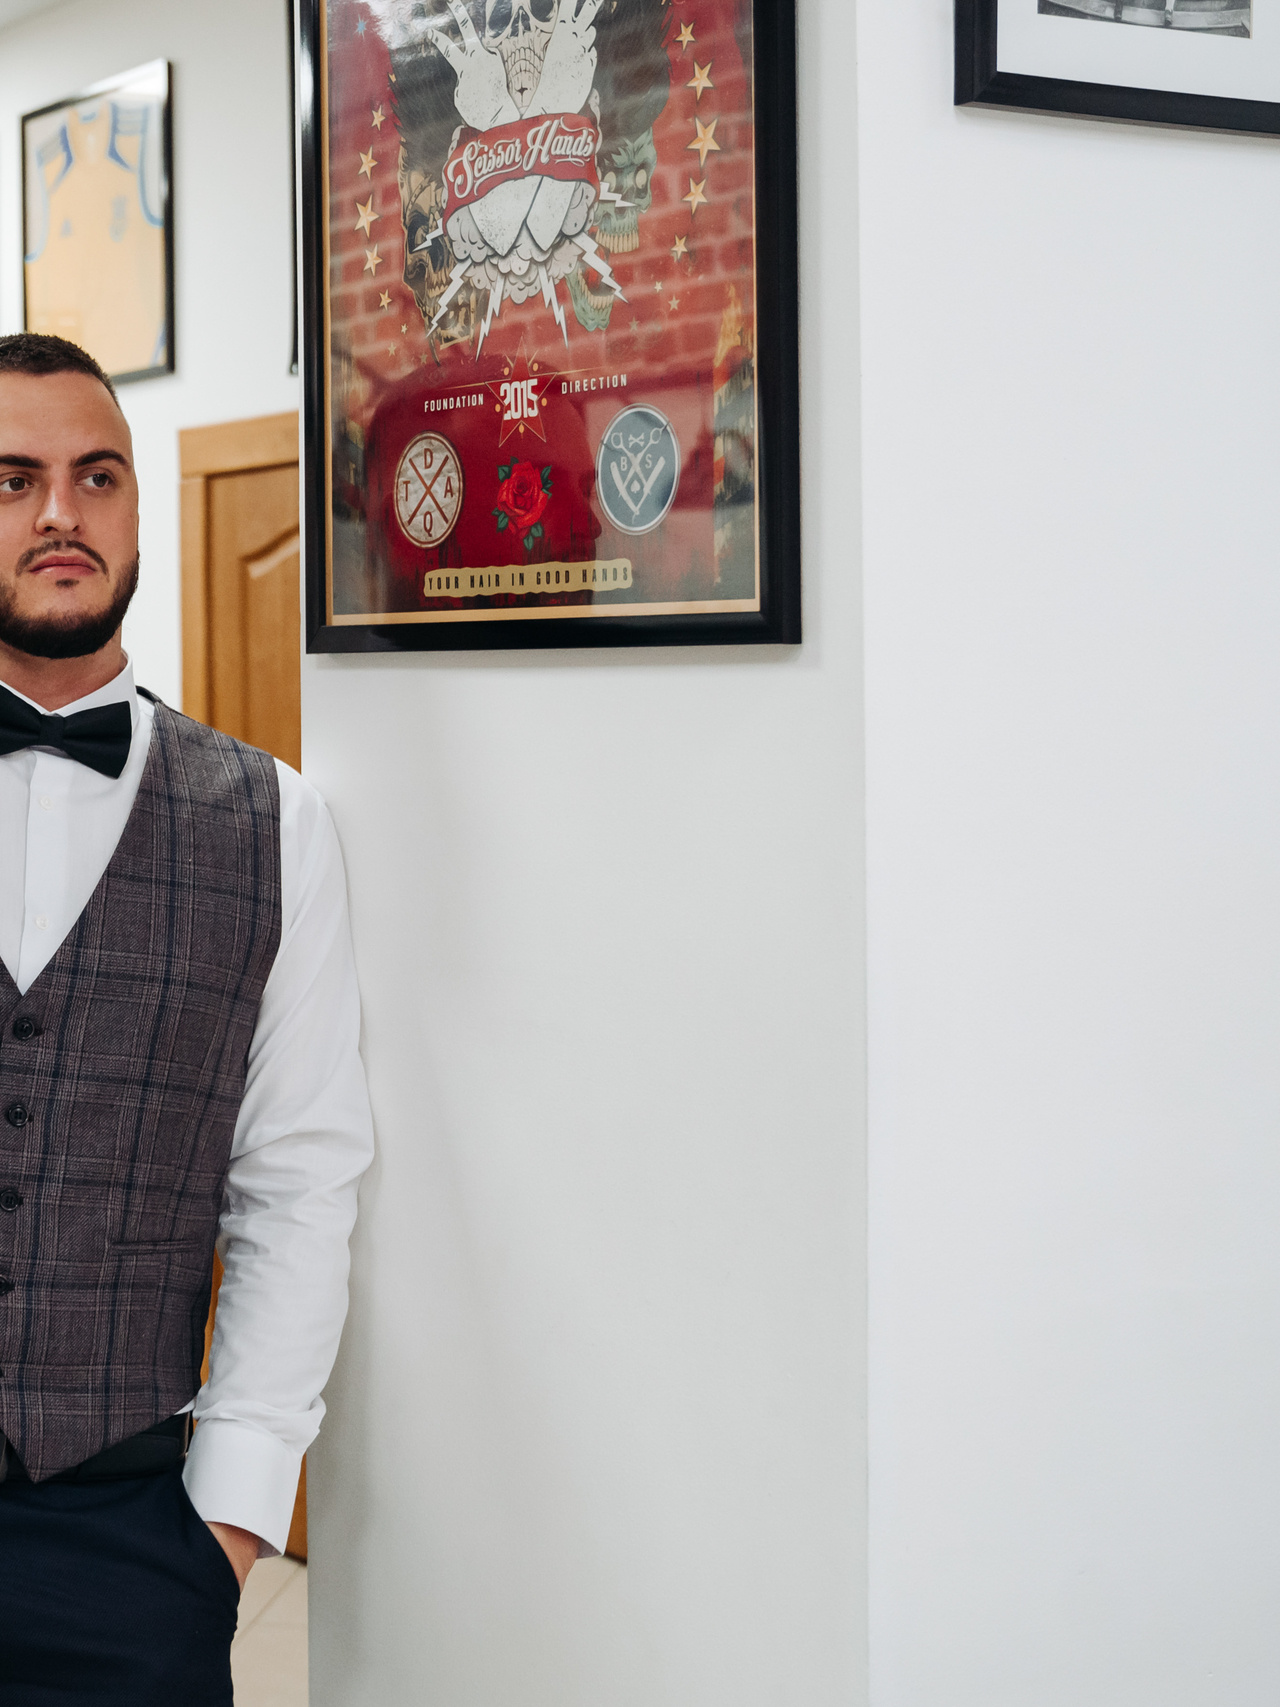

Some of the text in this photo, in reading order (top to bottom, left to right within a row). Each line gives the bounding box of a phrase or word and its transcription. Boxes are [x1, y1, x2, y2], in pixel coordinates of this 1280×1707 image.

[447, 116, 596, 198] Scissor Hands
[424, 374, 628, 421] FOUNDATION 2015 DIRECTION
[423, 448, 434, 470] D
[619, 453, 652, 471] B S
[402, 477, 454, 502] T A
[423, 511, 433, 537] Q
[428, 566, 628, 590] YOUR HAIR IN GOOD HANDS
